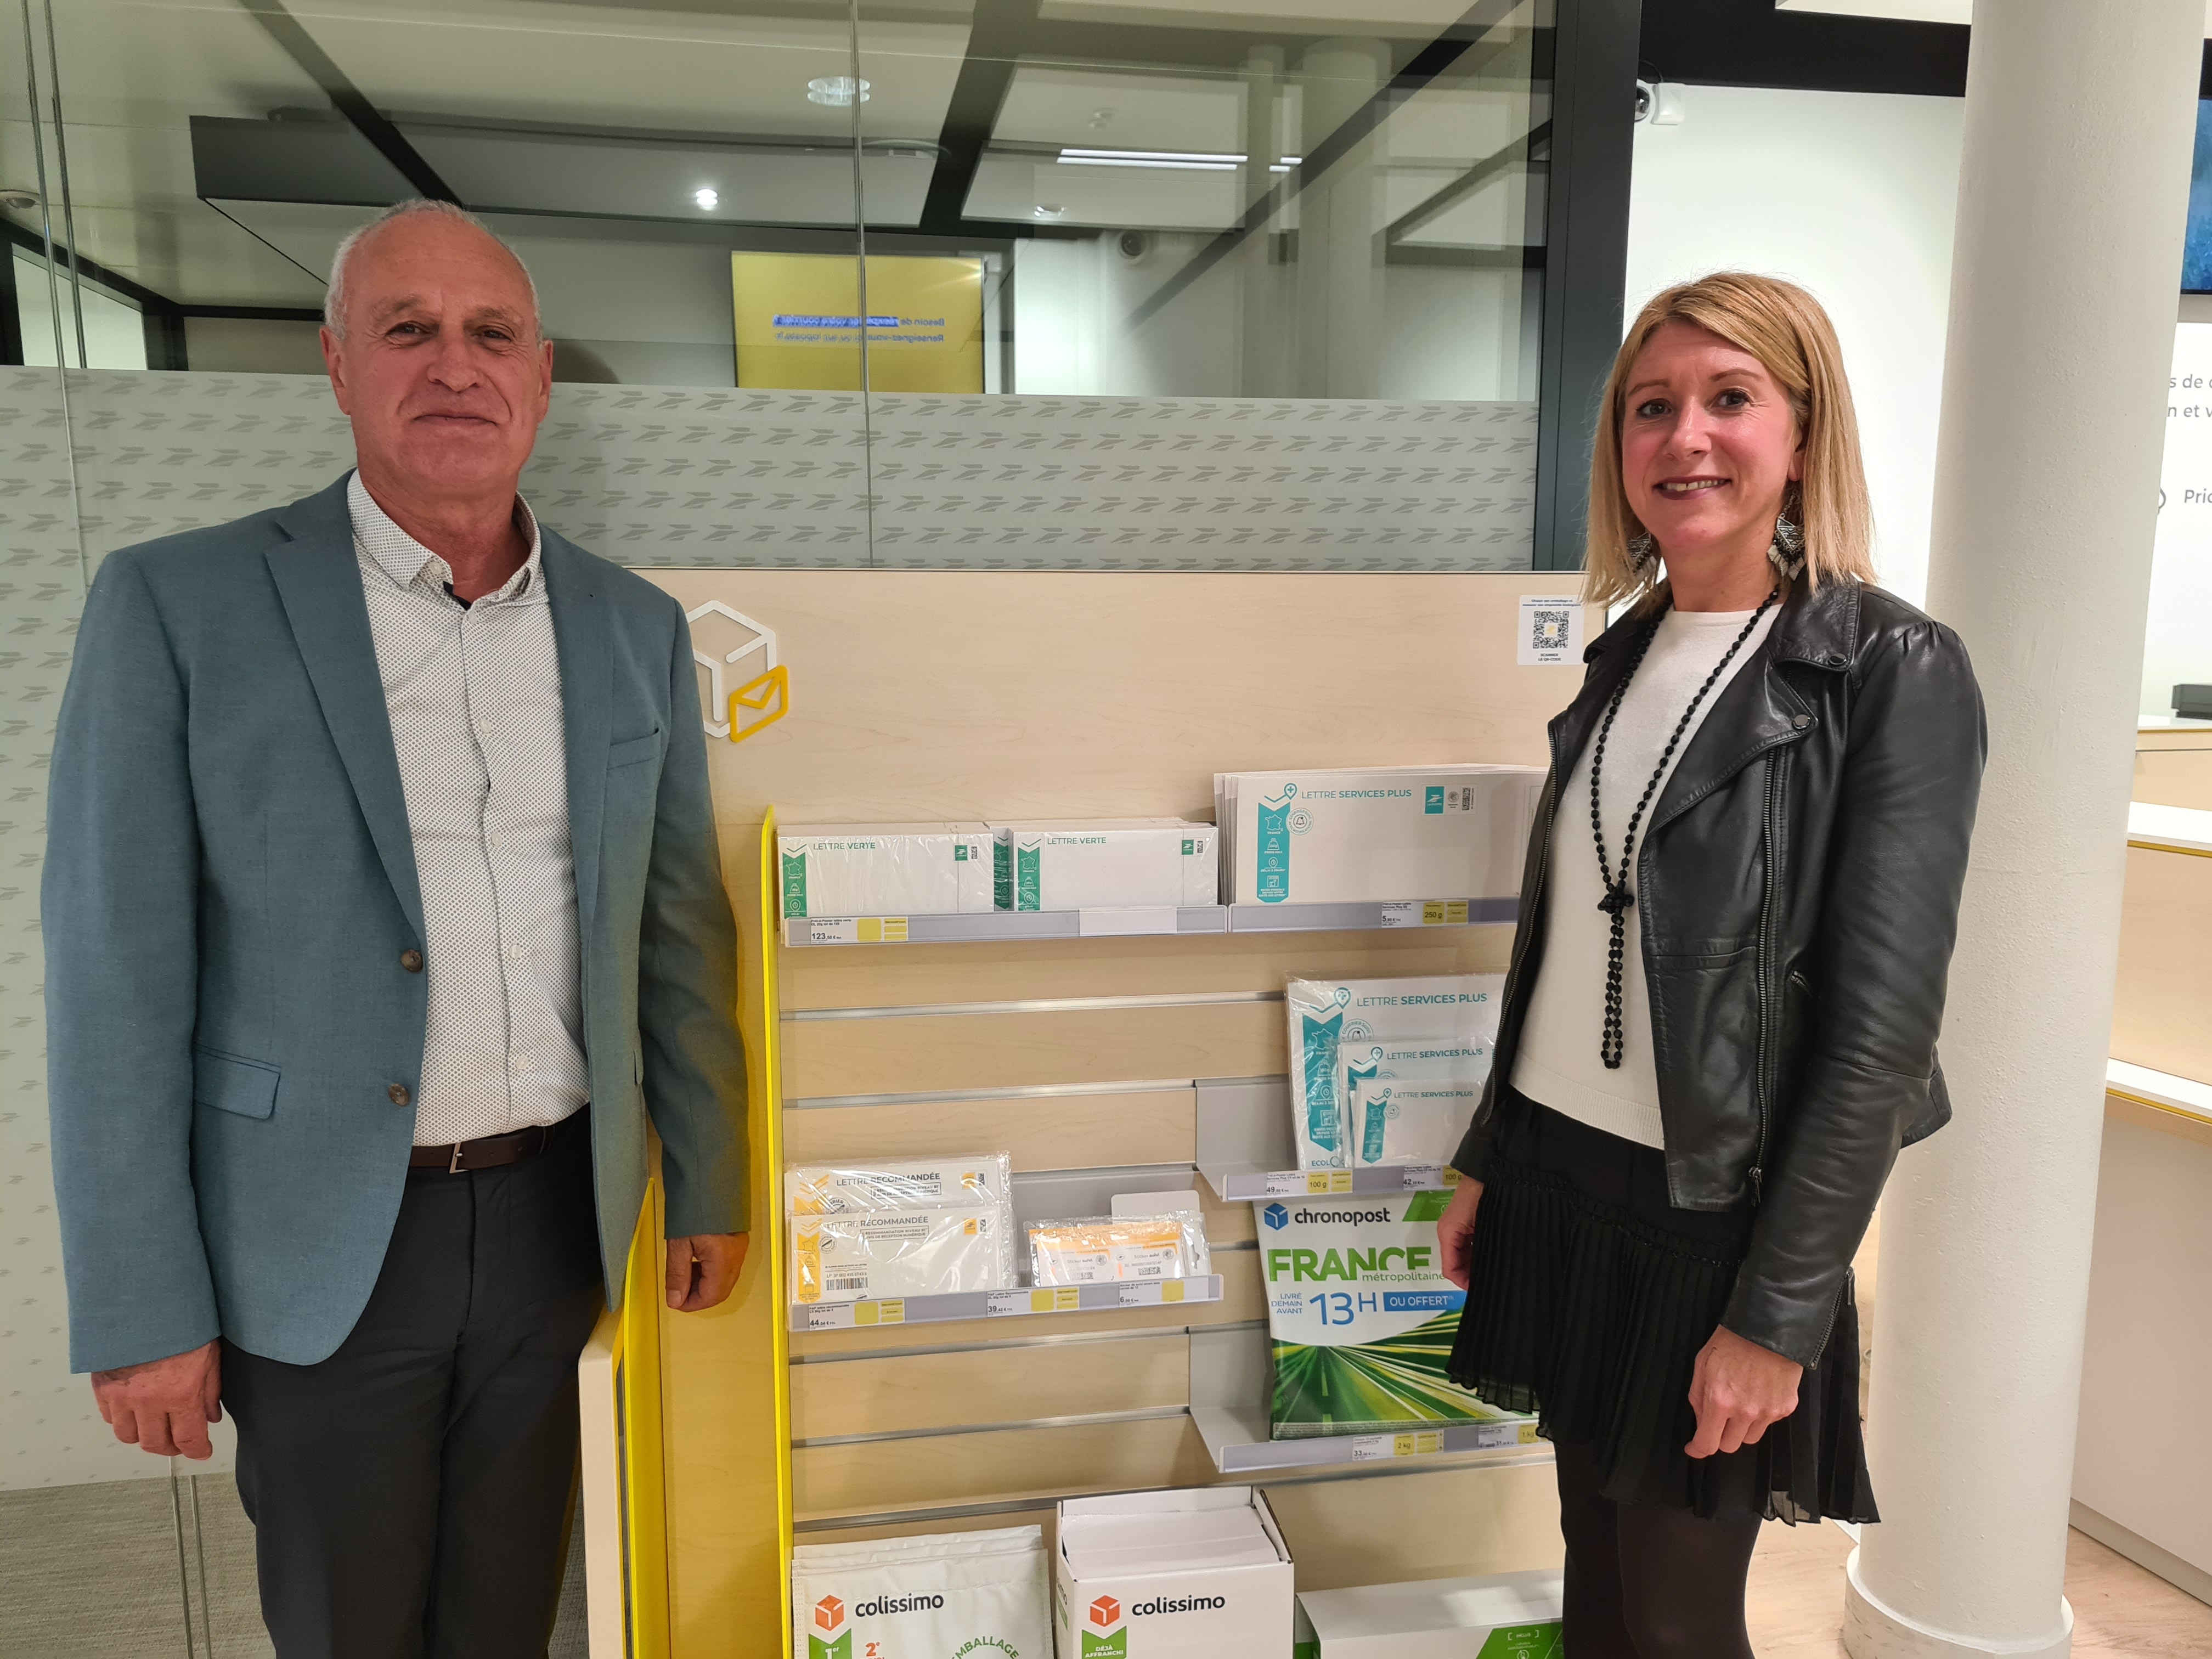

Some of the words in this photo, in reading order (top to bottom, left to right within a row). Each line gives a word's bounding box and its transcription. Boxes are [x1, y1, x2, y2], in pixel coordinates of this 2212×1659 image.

[2182, 374, 2203, 388] de
[2183, 404, 2199, 417] et
[1301, 791, 1336, 799] LETTRE
[1339, 790, 1385, 798] SERVICES
[1357, 997, 1397, 1007] LETTRE
[1401, 995, 1456, 1006] SERVICES
[1458, 993, 1488, 1003] PLUS
[1387, 1051, 1418, 1060] LETTRE
[1419, 1049, 1461, 1059] SERVICES
[1462, 1048, 1483, 1056] PLUS
[837, 1178, 868, 1186] LETTRE
[871, 1172, 940, 1183] RECOMMANDÉE
[827, 1221, 858, 1229] LETTRE
[860, 1215, 929, 1226] RECOMMANDÉE
[1294, 1207, 1391, 1227] chronopost
[1267, 1246, 1431, 1282] FRANCE
[1363, 1272, 1444, 1283] métropolitaine
[1390, 1296, 1406, 1306] OU
[855, 1593, 944, 1617] colissimo
[1132, 1595, 1225, 1616] colissimo
[952, 1636, 1019, 1659] MBALLAGE
[1085, 1650, 1123, 1658] AFFRANCHI
